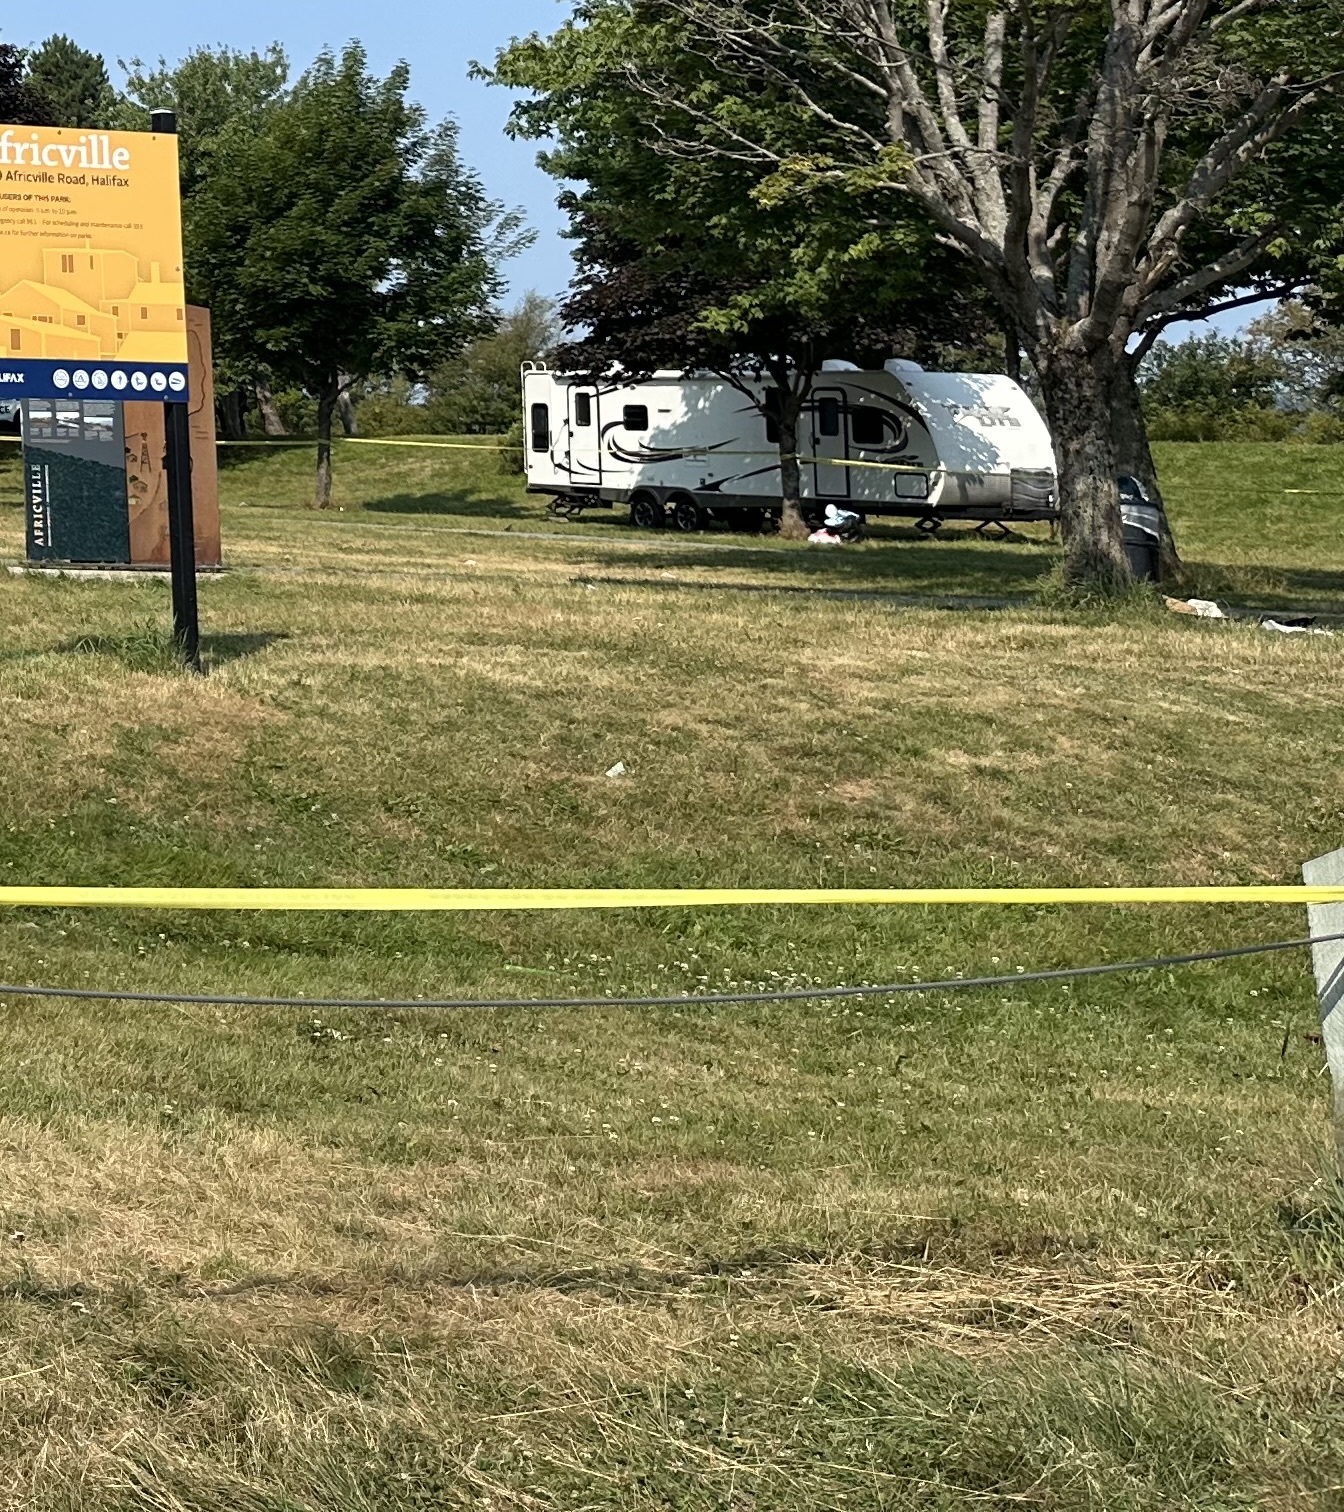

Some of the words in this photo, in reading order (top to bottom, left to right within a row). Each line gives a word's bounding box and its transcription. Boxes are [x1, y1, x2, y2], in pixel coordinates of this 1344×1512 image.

[6, 170, 54, 183] Africville
[57, 173, 89, 187] Road,
[91, 175, 129, 187] Halifax
[32, 464, 44, 546] AFRICVILLE
